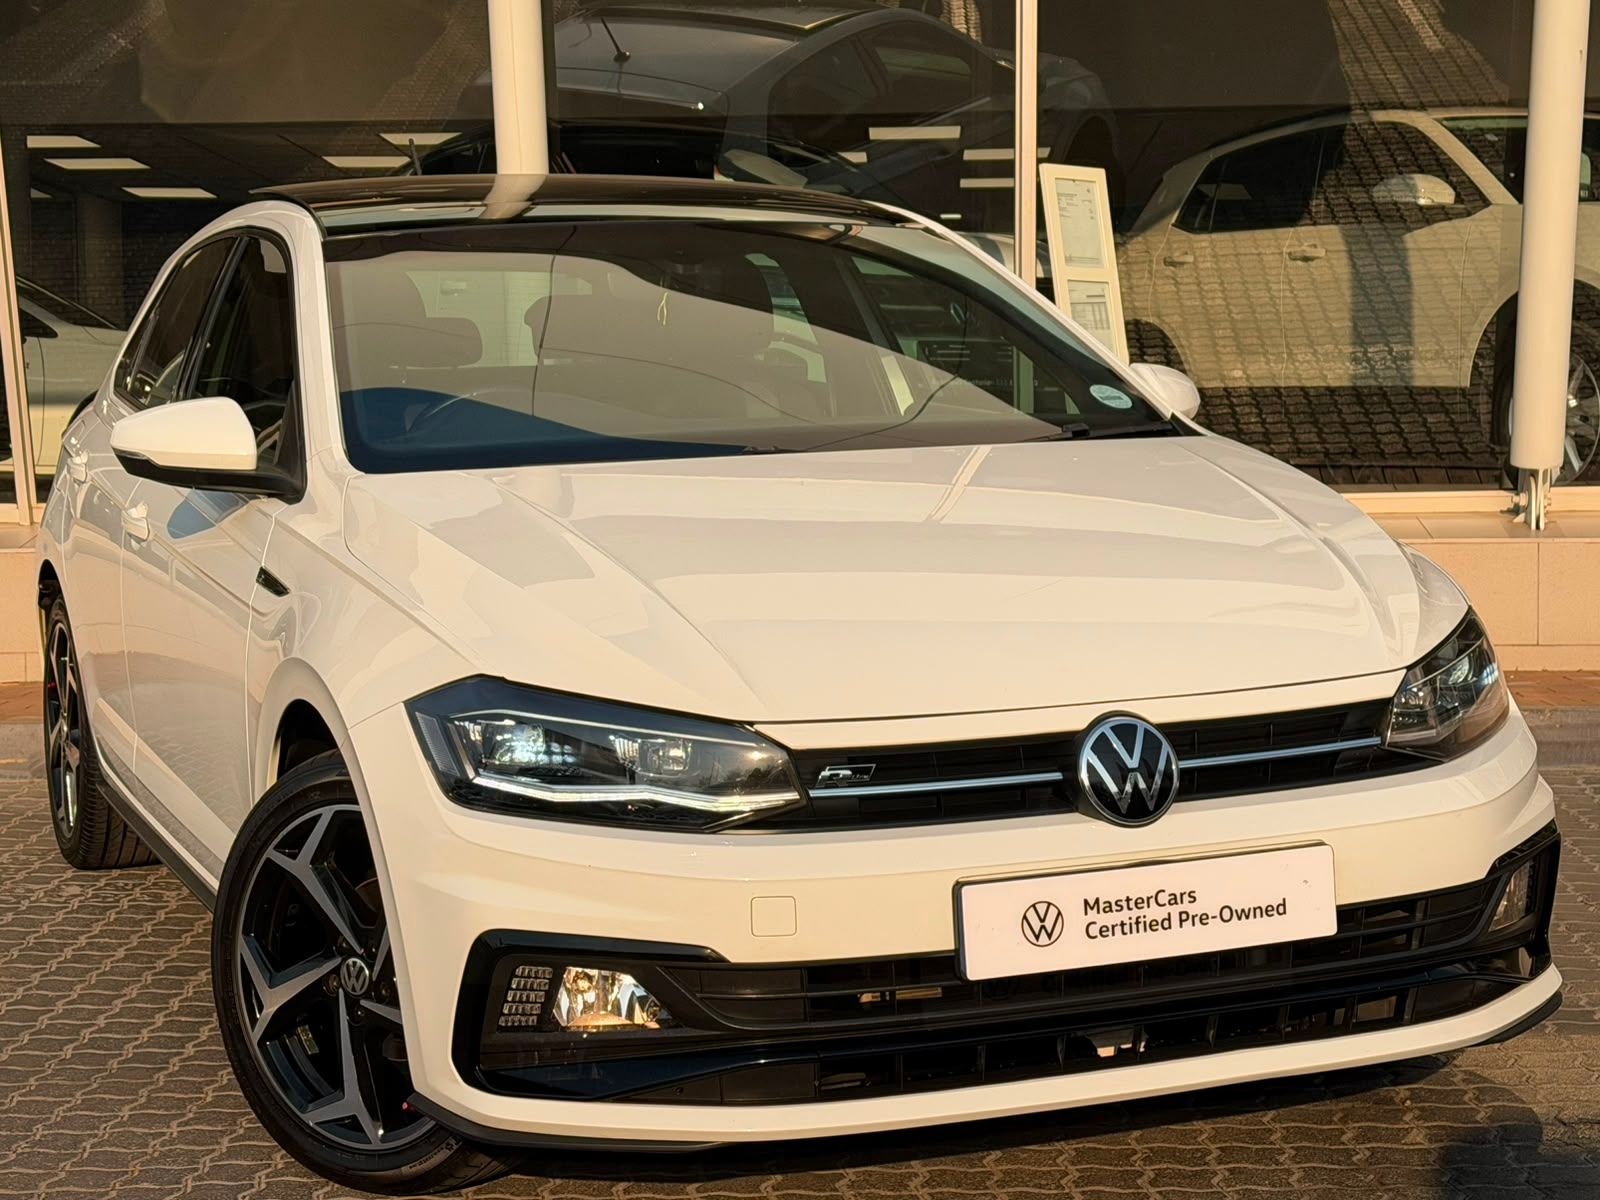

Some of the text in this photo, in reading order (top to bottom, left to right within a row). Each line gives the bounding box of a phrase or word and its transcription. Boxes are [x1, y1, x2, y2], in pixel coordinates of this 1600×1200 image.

[1081, 715, 1179, 825] VW
[1021, 900, 1064, 947] VW
[1083, 888, 1197, 917] MasterCars
[1085, 897, 1287, 940] Certified Pre-Owned
